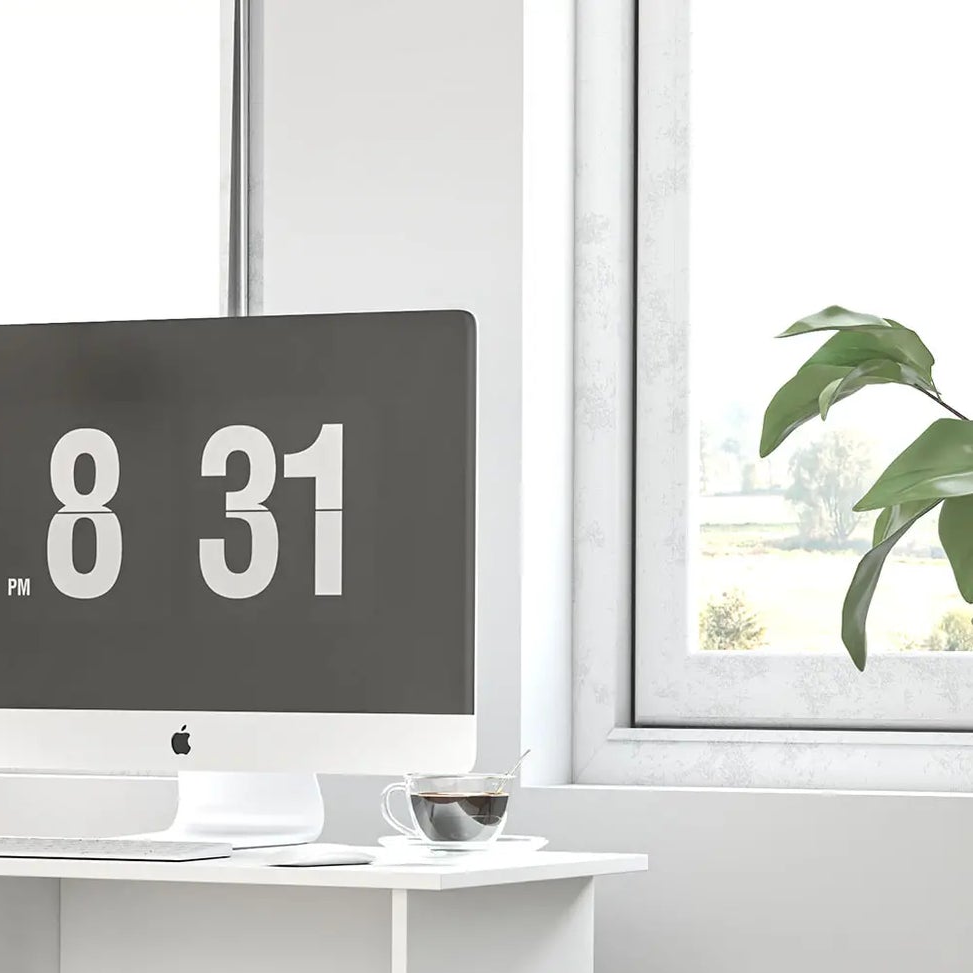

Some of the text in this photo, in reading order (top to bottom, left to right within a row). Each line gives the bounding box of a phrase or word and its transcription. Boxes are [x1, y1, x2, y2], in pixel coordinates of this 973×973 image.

[47, 423, 343, 600] 8 31
[7, 577, 31, 596] PM
